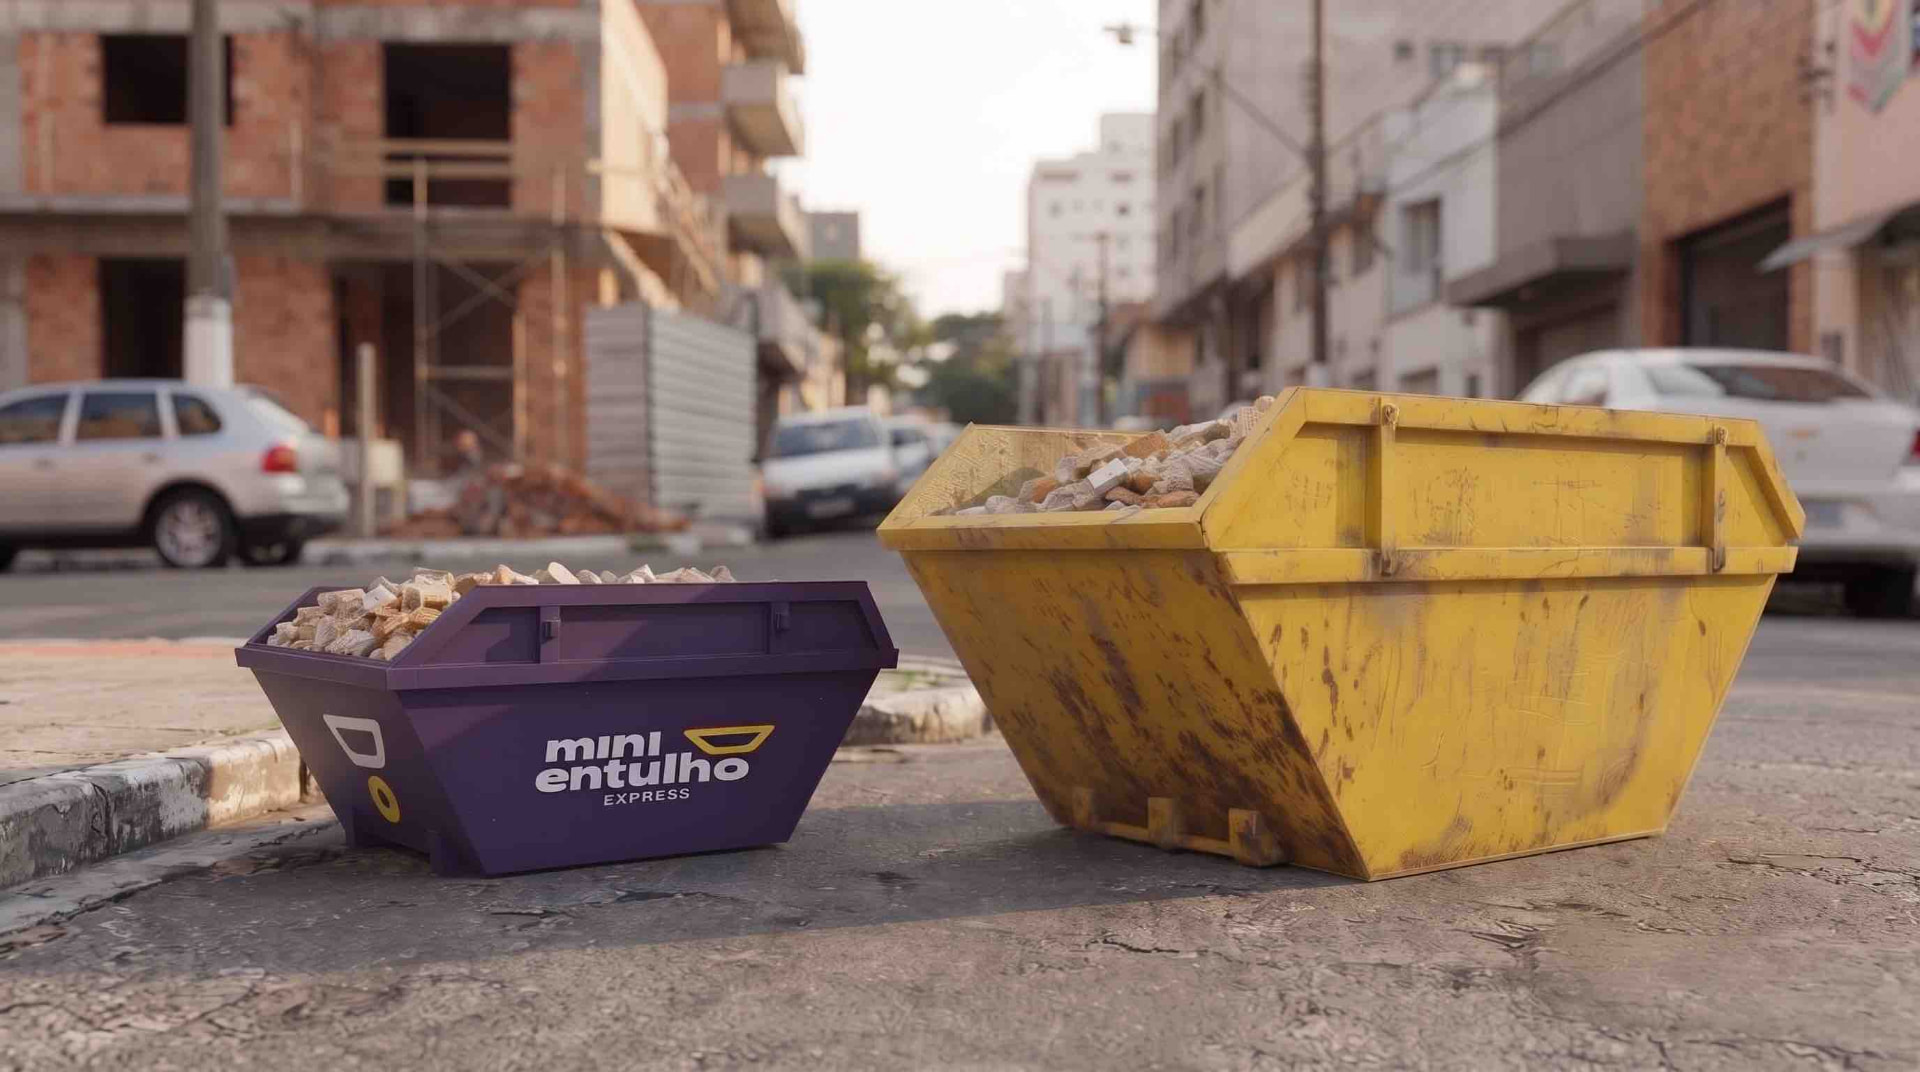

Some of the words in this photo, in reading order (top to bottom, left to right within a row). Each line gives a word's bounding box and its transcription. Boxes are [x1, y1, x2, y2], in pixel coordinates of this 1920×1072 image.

[545, 731, 662, 763] mini
[535, 751, 750, 793] entulho
[604, 789, 690, 805] EXPRESS
